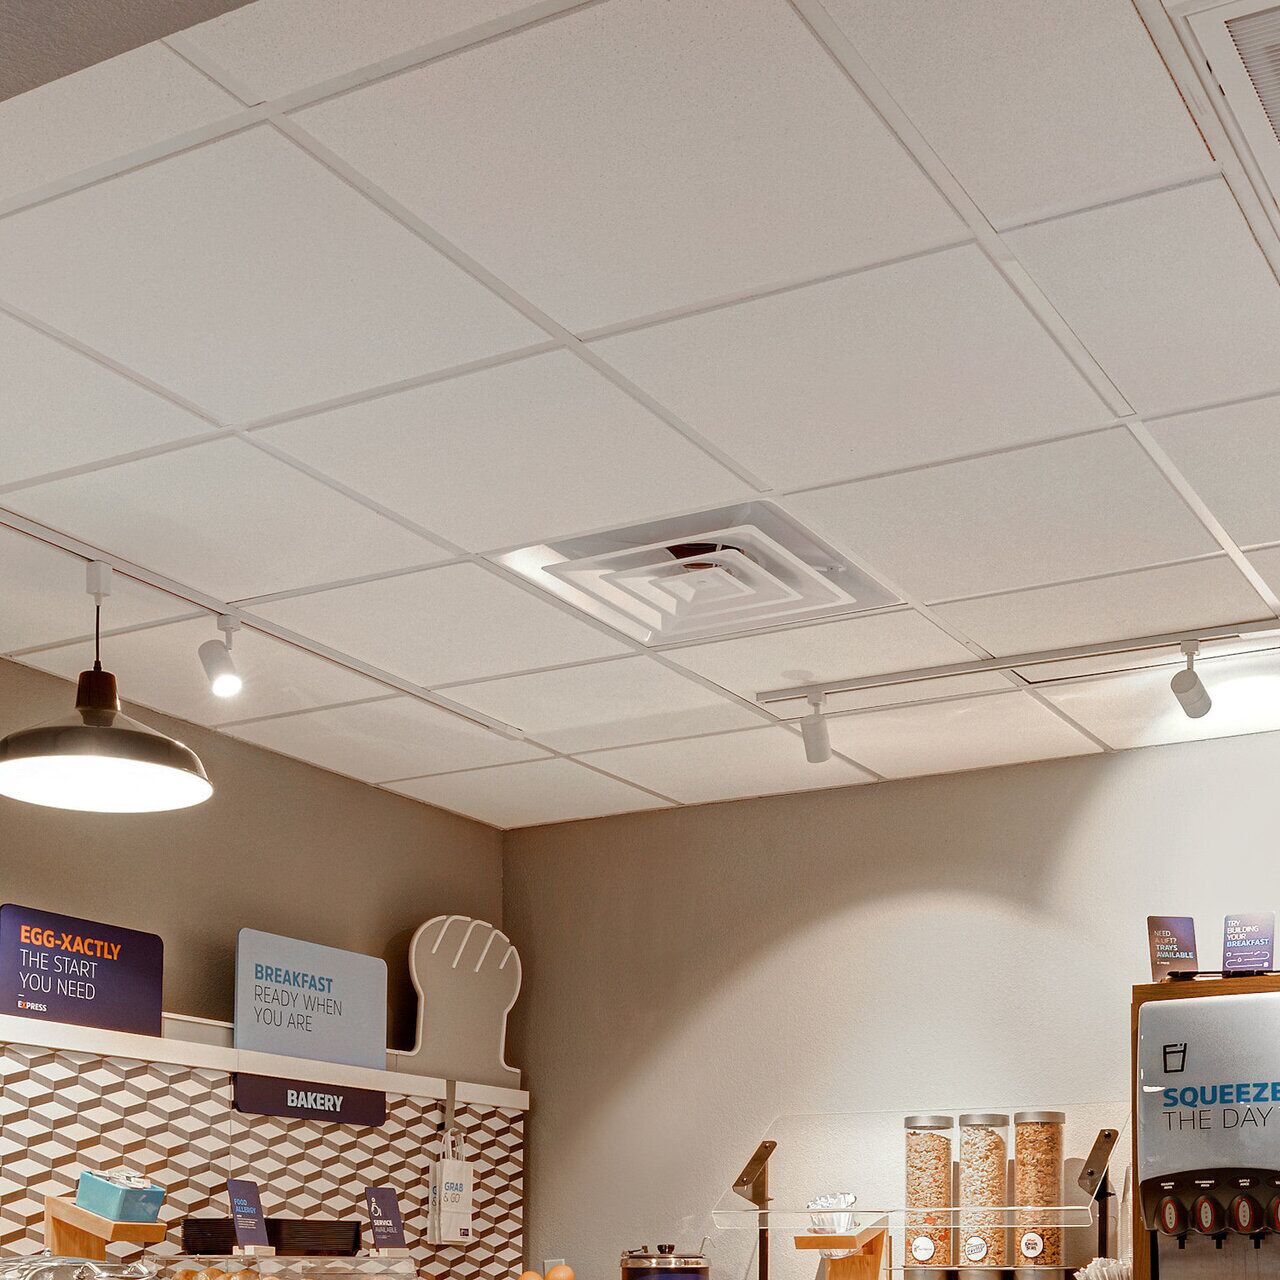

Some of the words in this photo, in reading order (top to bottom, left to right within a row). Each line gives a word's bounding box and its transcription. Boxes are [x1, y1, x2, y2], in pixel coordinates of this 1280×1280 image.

[1227, 926, 1260, 934] BUILDING
[20, 924, 122, 961] EGG-XACTLY
[1227, 933, 1247, 941] YOUR
[1227, 938, 1270, 948] BREAKFAST
[1156, 951, 1194, 959] AVAILABLE
[20, 948, 49, 971] THE
[54, 955, 98, 979] START
[255, 963, 333, 994] BREAKFAST
[19, 971, 52, 993] YOU
[57, 978, 96, 1000] NEED
[17, 1000, 48, 1012] EXPRESS
[254, 985, 299, 1008] READY
[303, 994, 342, 1016] WHEN
[254, 1006, 283, 1027] YOU
[287, 1013, 313, 1032] ARE
[287, 1089, 343, 1112] BAKERY
[1163, 1109, 1212, 1131] THE
[1223, 1106, 1273, 1129] DAY
[444, 1181, 464, 1193] GRAB
[234, 1198, 248, 1206] FOOD
[235, 1205, 257, 1214] ALLERGY
[373, 1219, 394, 1227] SERVICE
